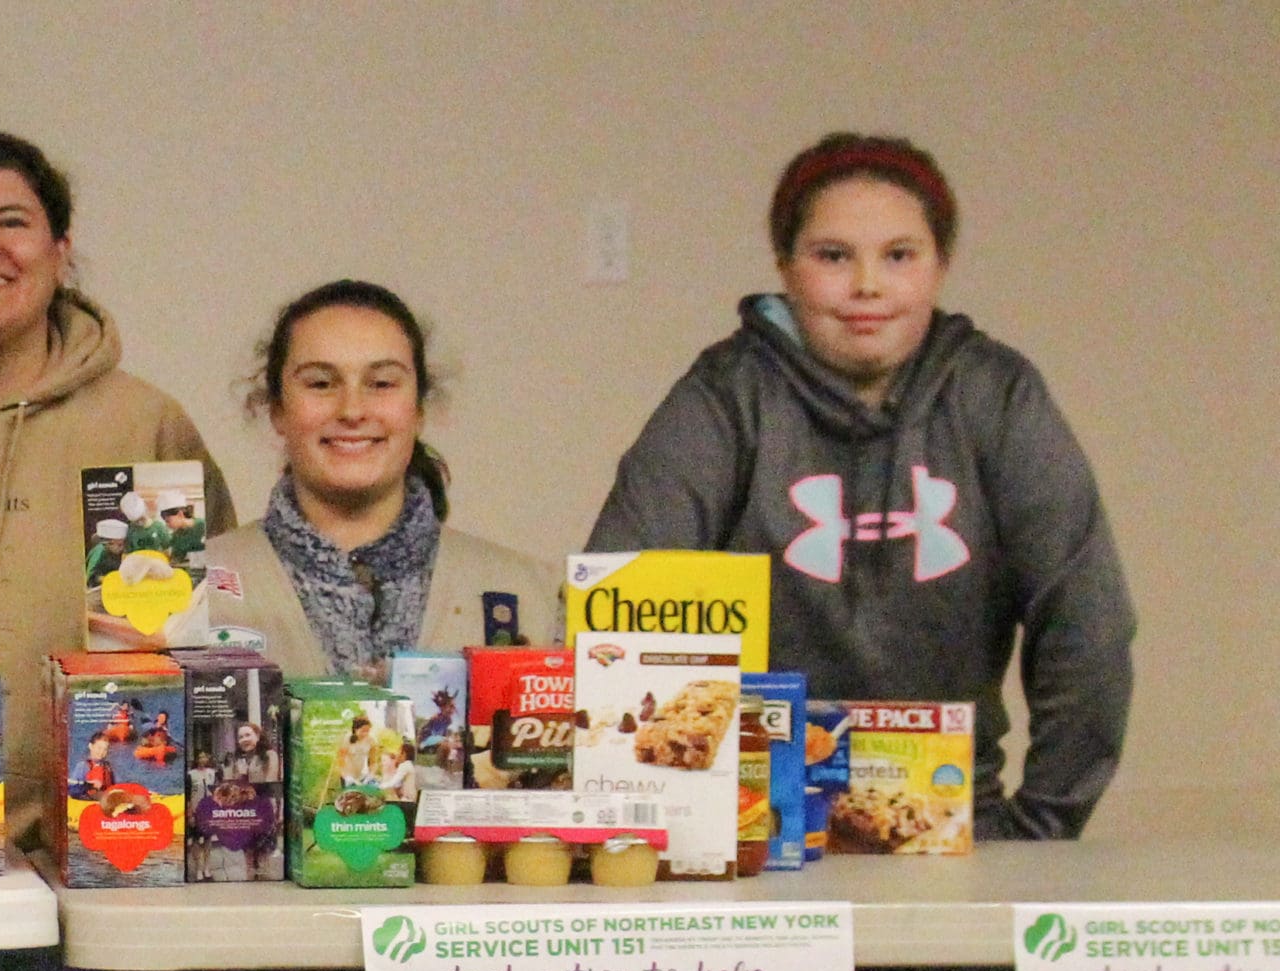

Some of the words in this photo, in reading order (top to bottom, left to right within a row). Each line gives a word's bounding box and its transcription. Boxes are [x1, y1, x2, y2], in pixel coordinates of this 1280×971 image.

[584, 587, 748, 634] Cheerios
[520, 694, 574, 712] HOUS
[876, 709, 936, 728] PACK
[851, 765, 908, 779] rotein
[212, 809, 256, 818] samoas
[101, 820, 150, 832] tagalongs
[331, 821, 353, 833] thin
[354, 821, 387, 833] mints
[434, 920, 480, 936] GIRL
[485, 919, 566, 935] SCOUTS
[571, 918, 598, 933] OF
[604, 916, 726, 932] NORTHEAST
[731, 915, 779, 930] NEW
[786, 914, 840, 929] YORK
[1085, 920, 1129, 935] GIRL
[1136, 920, 1214, 935] SCOUTS
[1220, 919, 1248, 934] OF
[435, 940, 540, 959] SERVICE
[547, 939, 604, 957] UNIT
[611, 937, 645, 956] 151
[1086, 939, 1189, 958] SERVICE
[1197, 938, 1250, 956] UNIT
[1262, 937, 1280, 956] 15
